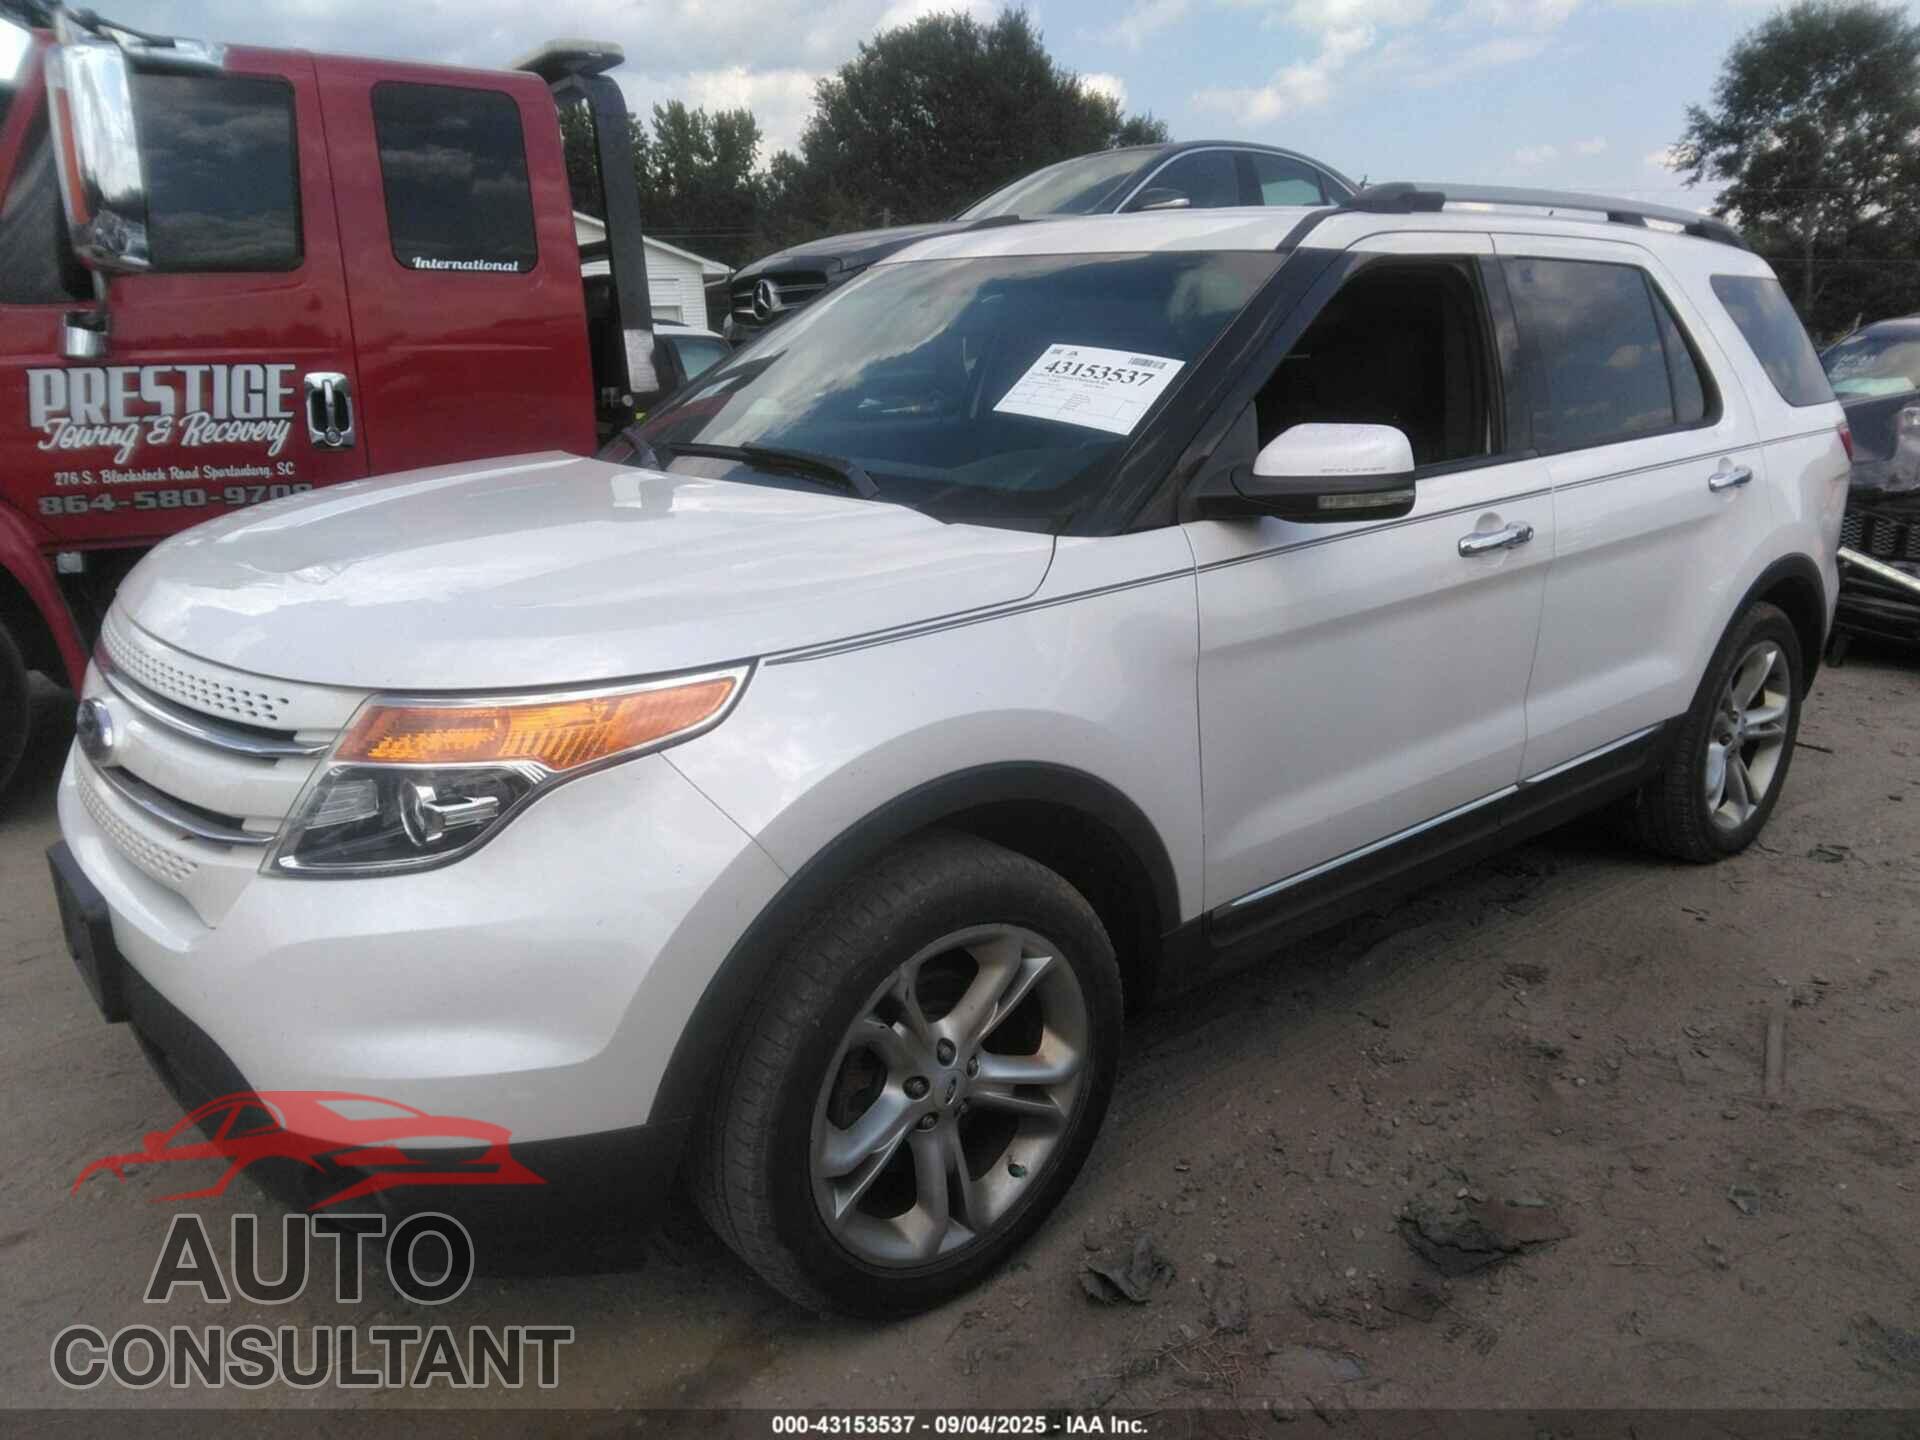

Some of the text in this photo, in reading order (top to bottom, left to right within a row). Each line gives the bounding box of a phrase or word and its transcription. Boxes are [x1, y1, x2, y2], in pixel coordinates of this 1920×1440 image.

[412, 256, 518, 272] International
[1044, 360, 1154, 387] 43153537
[26, 364, 296, 428] PRESTIGE
[37, 411, 291, 464] Towing & Recovery
[169, 465, 200, 480] Road
[276, 461, 296, 476] SC
